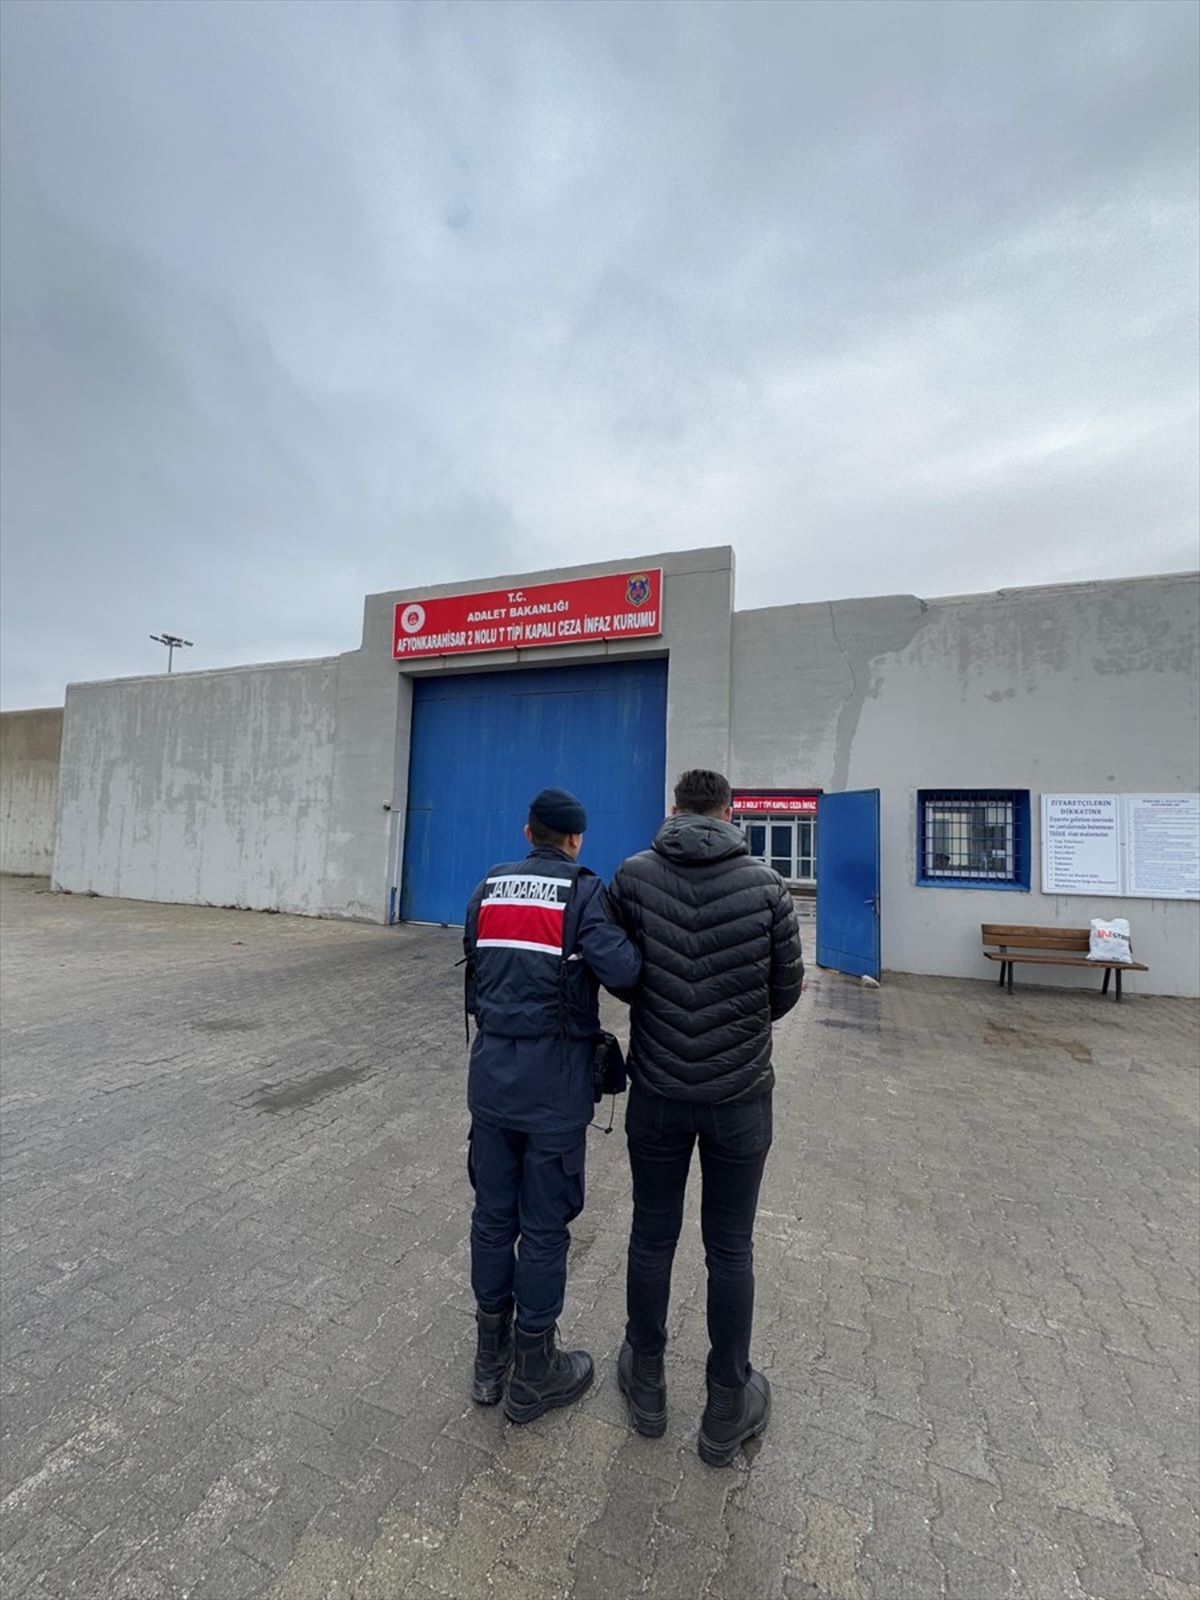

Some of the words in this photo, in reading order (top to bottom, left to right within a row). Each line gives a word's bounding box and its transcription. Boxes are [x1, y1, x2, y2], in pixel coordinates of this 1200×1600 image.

[507, 592, 527, 603] T.C.
[467, 608, 506, 622] ADALET
[509, 600, 569, 618] BAKANLIĞI
[396, 630, 466, 652] AFYONKARAHİSAR
[467, 631, 473, 646] 2
[474, 627, 497, 644] NOLU
[499, 627, 505, 643] T
[506, 622, 524, 641] TİPİ
[525, 621, 556, 639] KAPALI
[558, 619, 581, 636] CEZA
[583, 614, 611, 633] İNFAZ
[613, 611, 656, 631] KURUMU
[488, 880, 558, 903] JANDARMA
